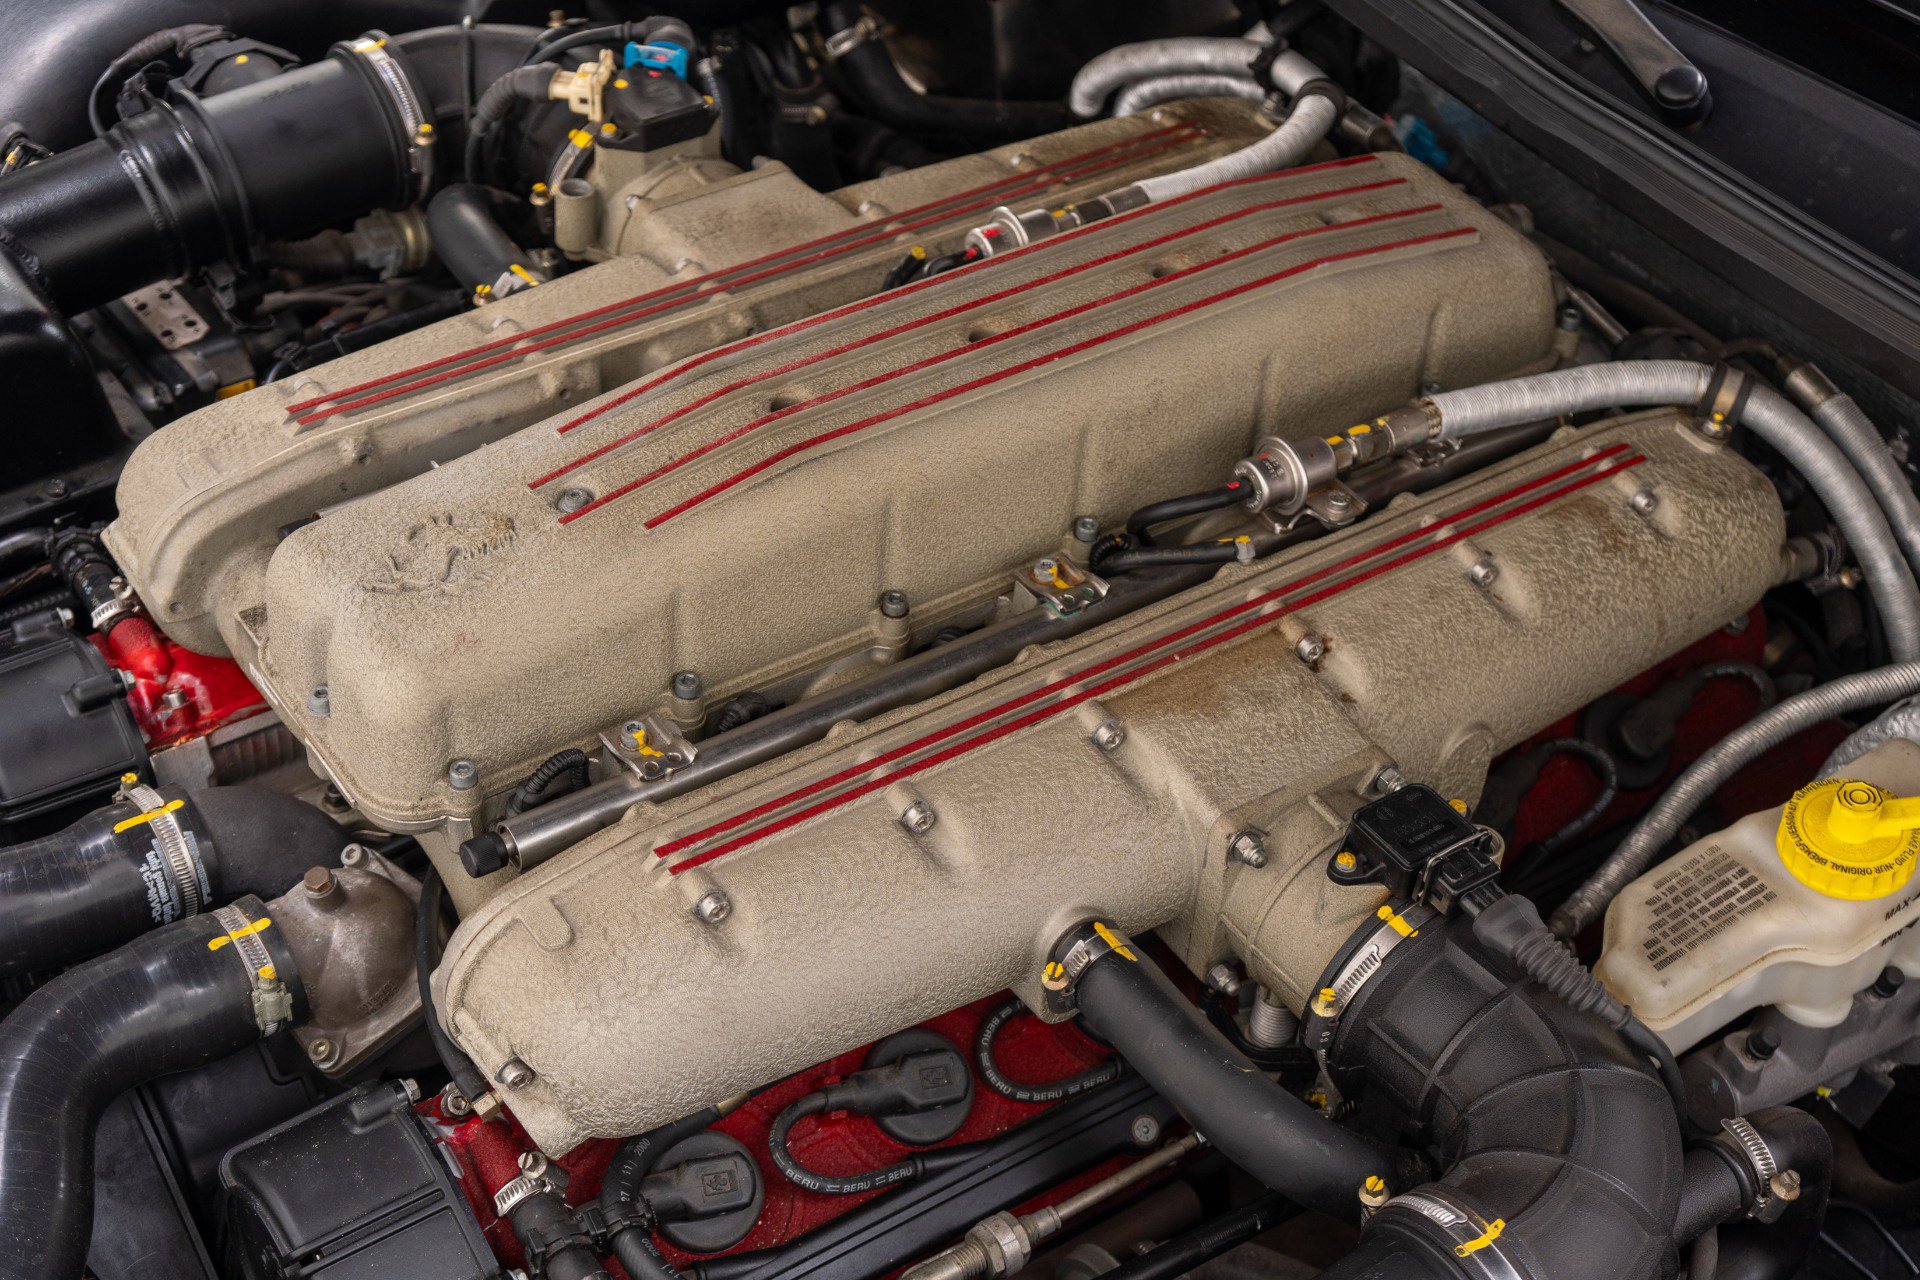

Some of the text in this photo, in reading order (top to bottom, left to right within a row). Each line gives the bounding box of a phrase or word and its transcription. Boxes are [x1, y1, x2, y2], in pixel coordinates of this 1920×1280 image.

[1896, 846, 1915, 866] FLUID
[1831, 862, 1872, 875] ORIGINAL
[981, 1017, 1000, 1045] BERU
[985, 1069, 1012, 1095] BERU
[1082, 1072, 1111, 1089] BERU
[1032, 1089, 1063, 1101] BERU
[620, 1191, 630, 1202] 27
[634, 1138, 651, 1156] 2000
[887, 1166, 913, 1181] BERU
[785, 1168, 819, 1191] BERU
[842, 1181, 871, 1193] BERU
